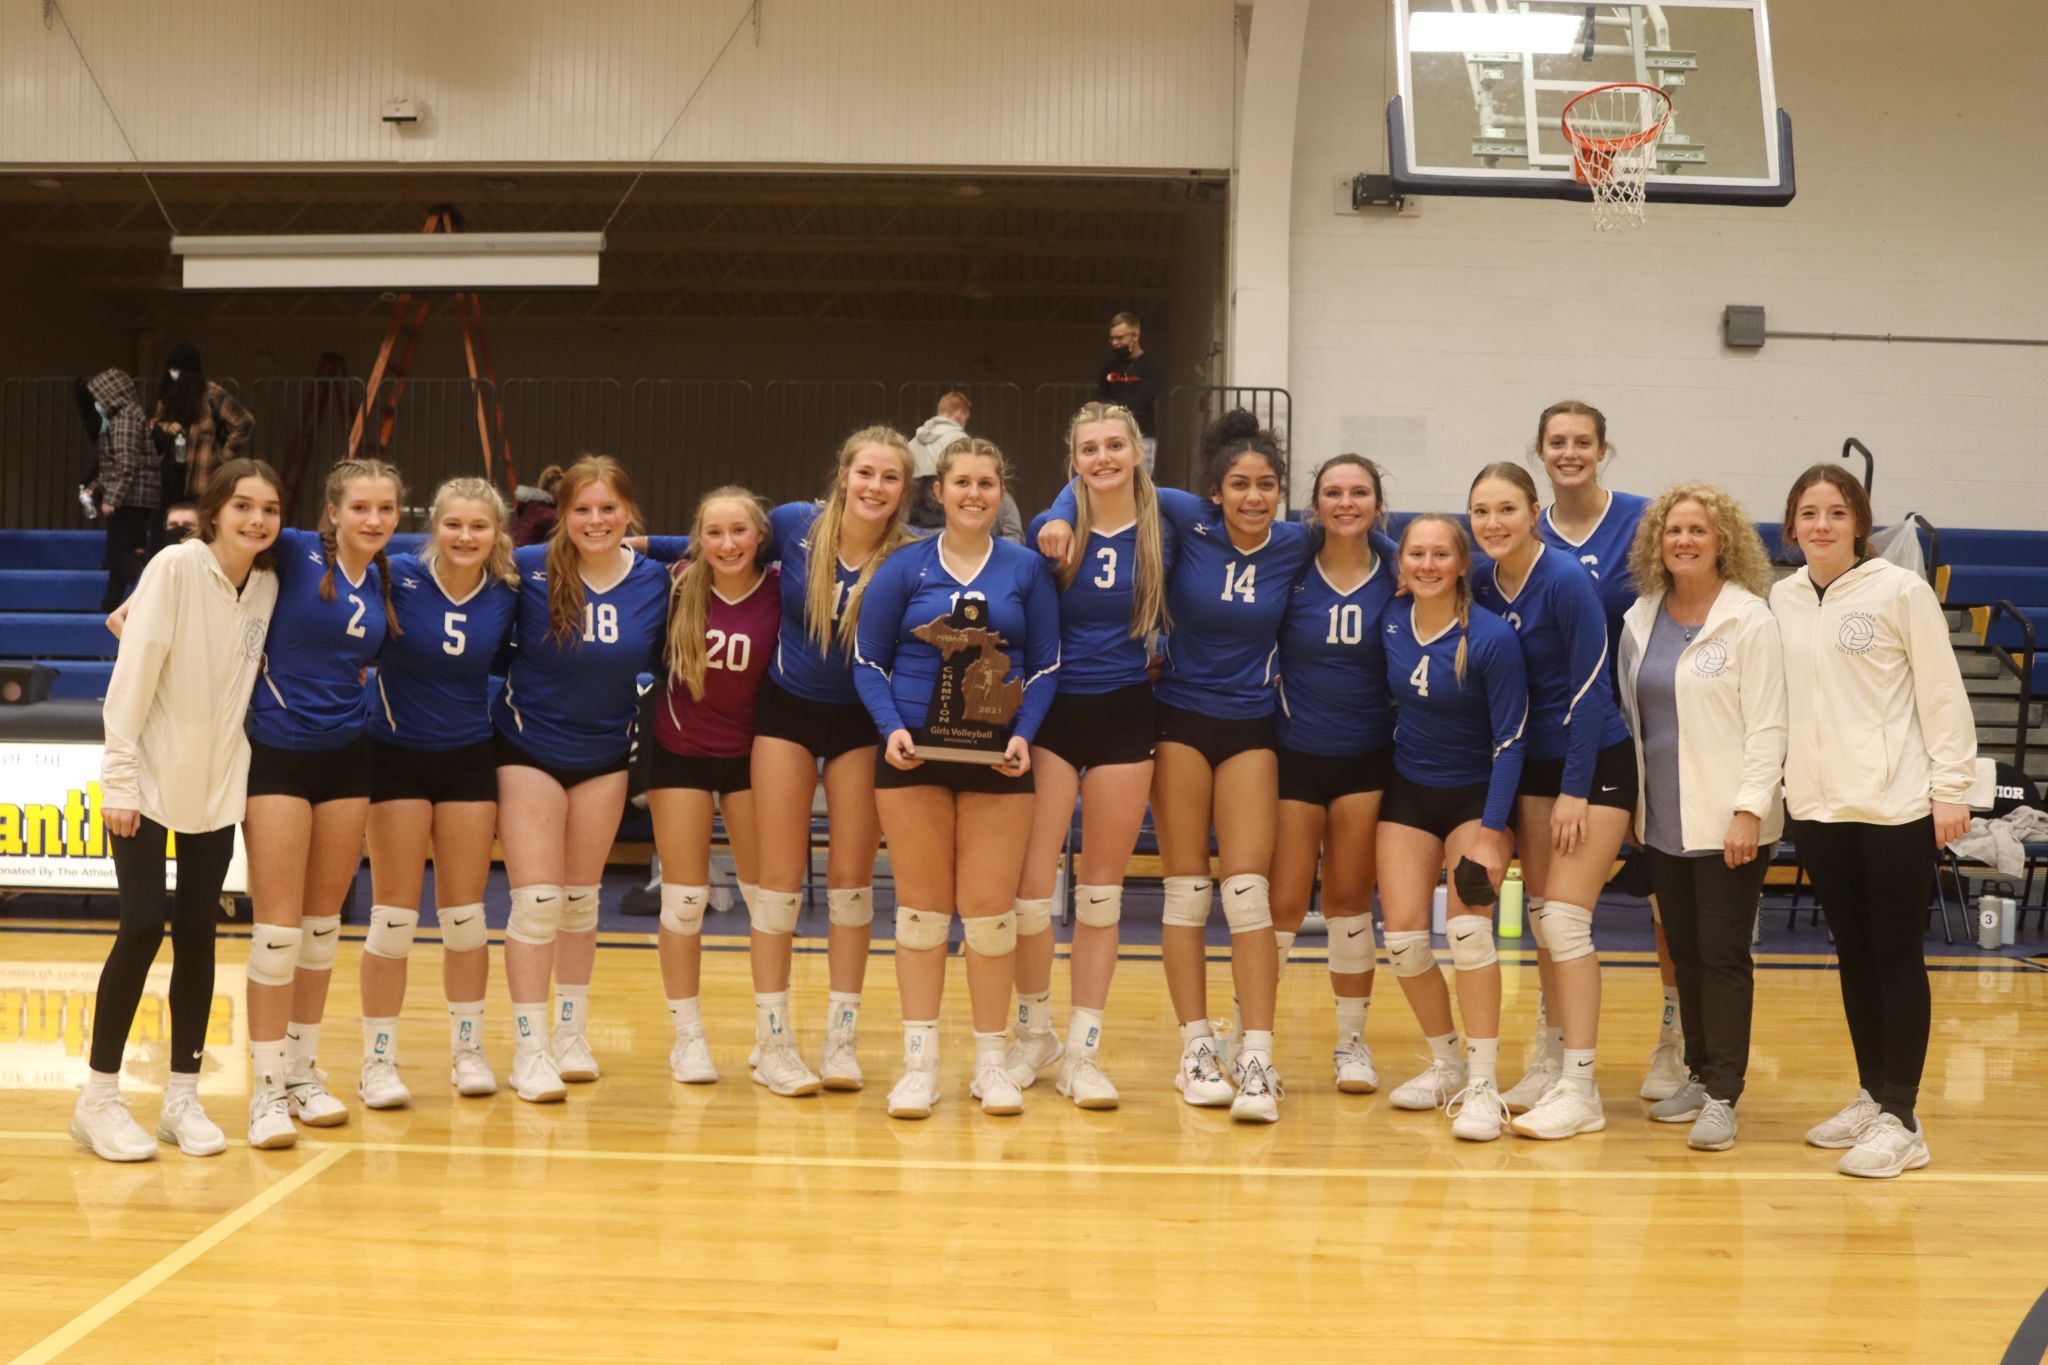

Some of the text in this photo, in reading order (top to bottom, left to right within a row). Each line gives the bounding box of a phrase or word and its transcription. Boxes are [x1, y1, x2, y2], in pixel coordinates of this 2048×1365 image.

[1094, 547, 1117, 588] 3
[1221, 561, 1256, 603] 14
[346, 594, 366, 638] 2
[442, 611, 467, 656] 5
[583, 602, 619, 644] 18
[1326, 604, 1362, 644] 10
[705, 629, 751, 672] 20
[939, 666, 953, 723] CHAMPION
[1410, 655, 1430, 697] 4
[979, 706, 1002, 714] 2021
[930, 726, 993, 739] Girls Volleyball
[1995, 785, 2024, 800] IOR
[1985, 914, 1993, 925] 3
